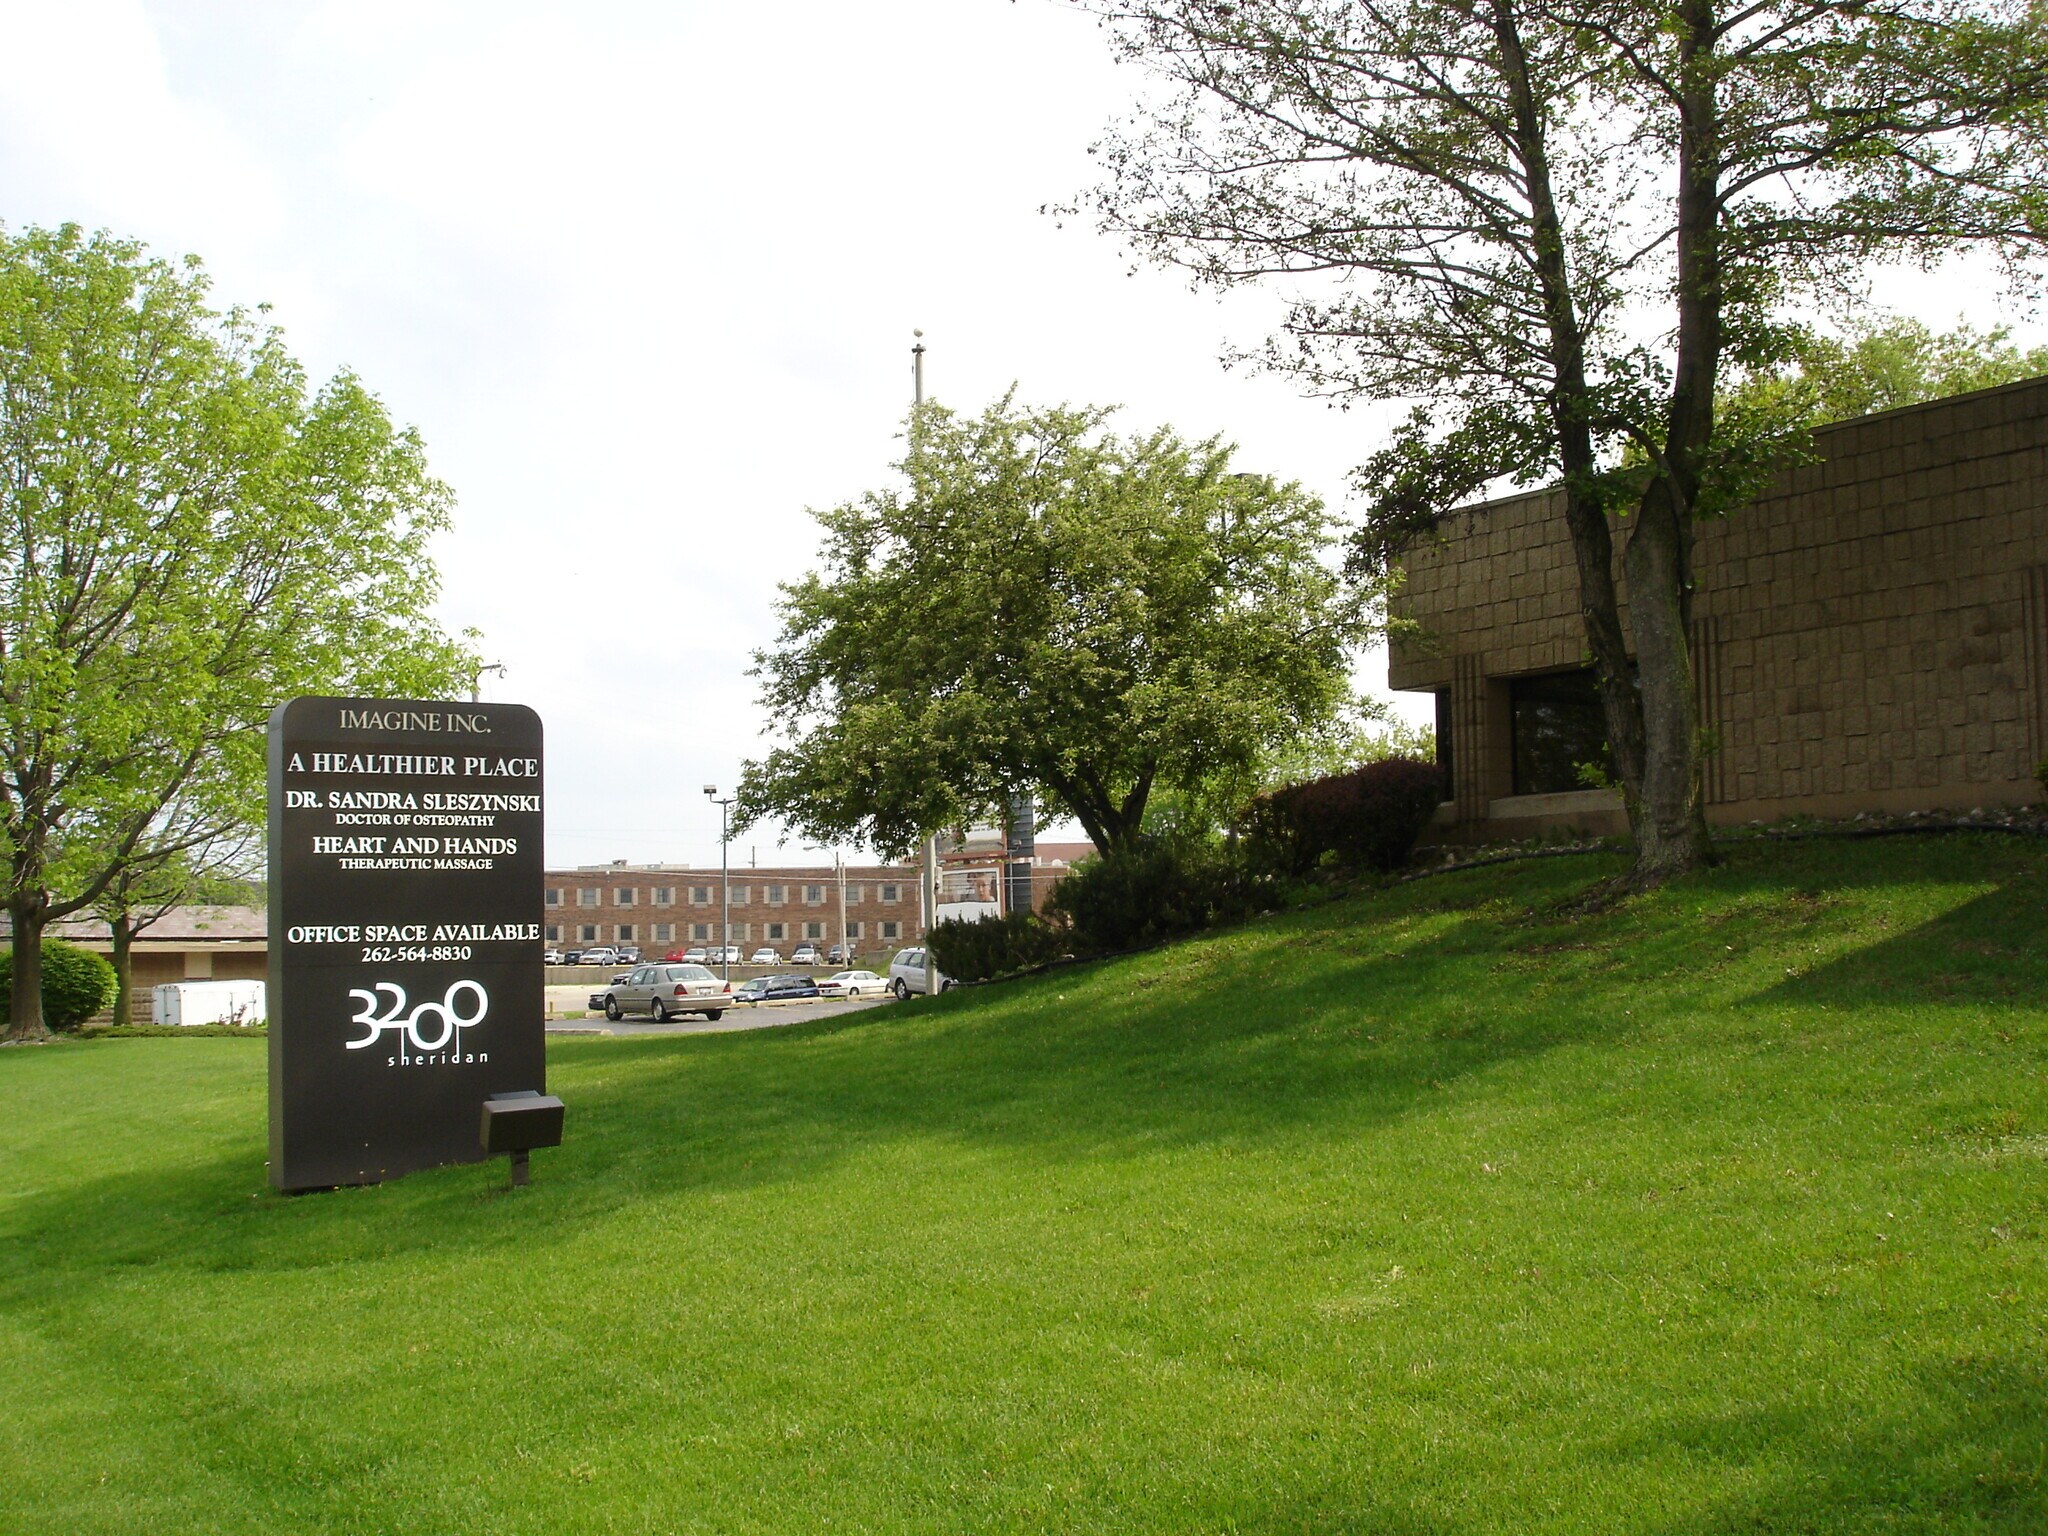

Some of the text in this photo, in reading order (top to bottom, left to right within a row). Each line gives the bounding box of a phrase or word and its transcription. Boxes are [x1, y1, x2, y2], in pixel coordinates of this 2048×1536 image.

[341, 710, 491, 733] IMAGINE INC.
[288, 753, 538, 777] A HEALTHIER PLACE
[286, 791, 540, 811] DR. SANDRA SLESZYNSKI
[336, 814, 495, 826] DOCTOR OF OSTEOPATHY
[313, 837, 517, 854] HEART AND HANDS
[339, 858, 493, 869] THERAPEUTIC MASSAGE
[288, 924, 540, 943] OFFICE SPACE AVAILABLE
[362, 946, 471, 962] 262-564-8830
[346, 980, 488, 1050] 3200
[388, 1050, 487, 1066] sheridan
